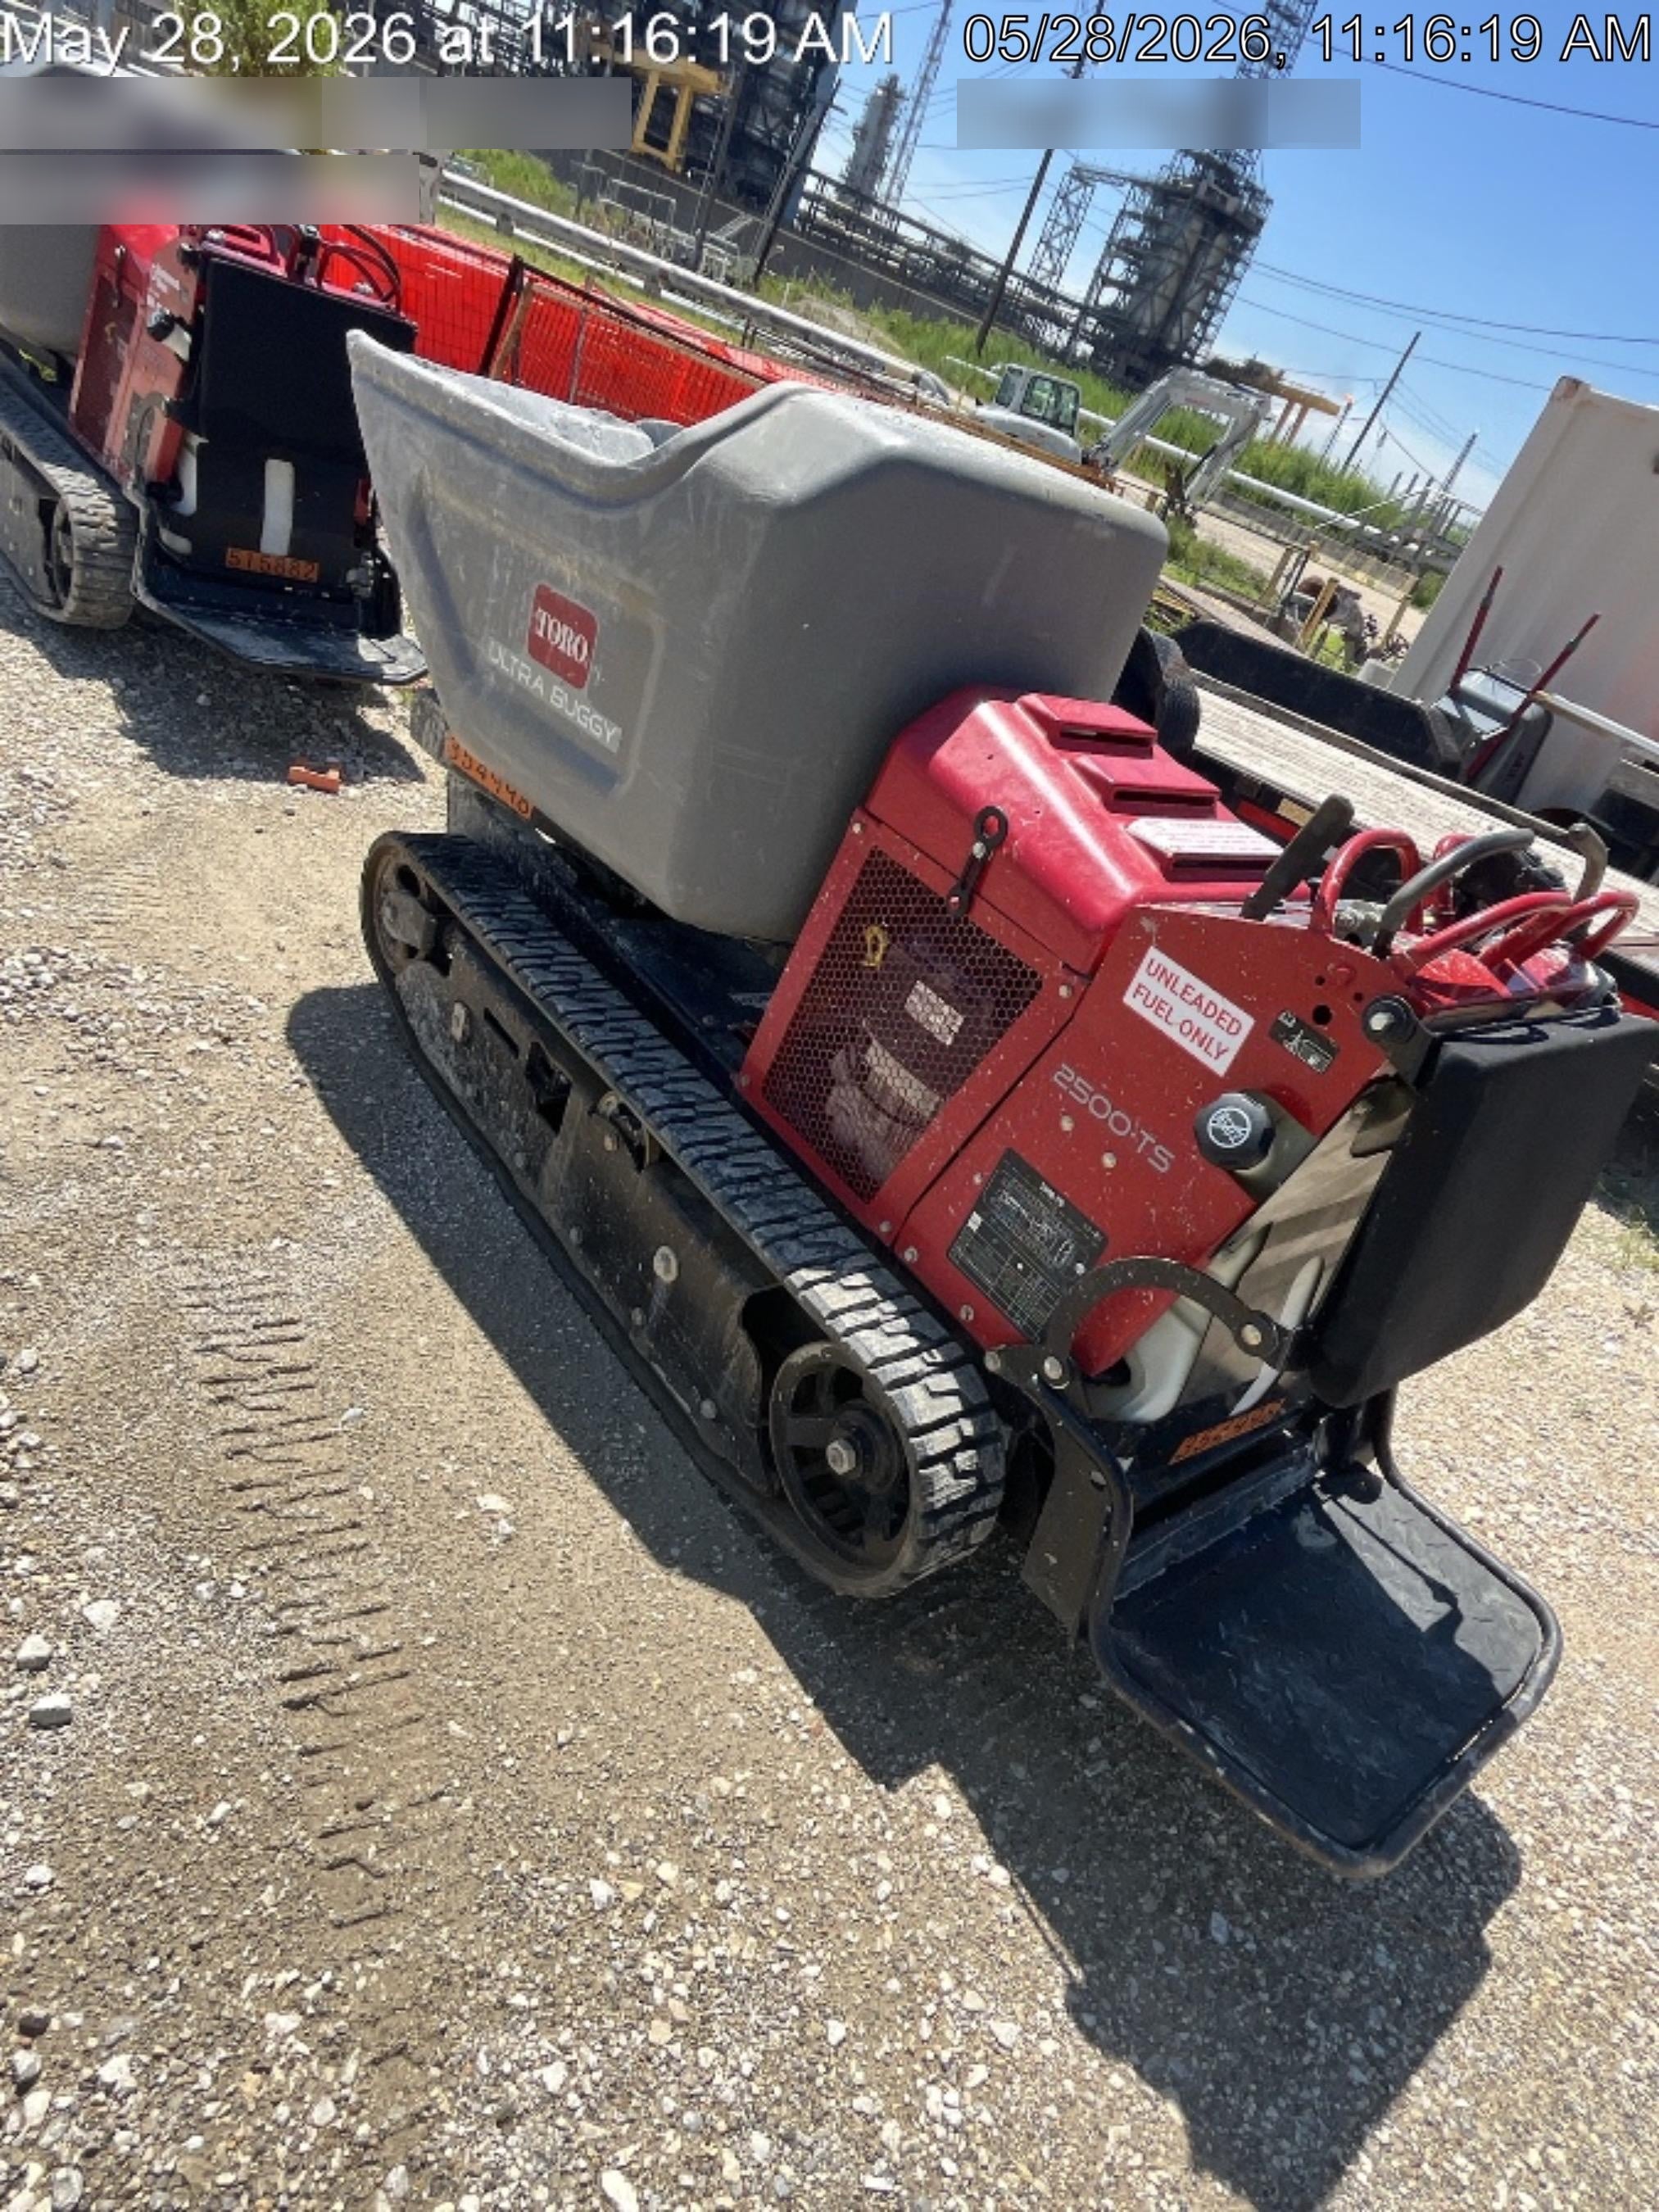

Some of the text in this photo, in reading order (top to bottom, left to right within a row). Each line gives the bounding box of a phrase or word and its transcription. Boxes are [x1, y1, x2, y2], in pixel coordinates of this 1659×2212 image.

[535, 606, 588, 662] TORO
[488, 639, 618, 743] ULTRA BUGGY
[1132, 982, 1174, 1026] FUEL
[1179, 1018, 1230, 1061] ONLY
[1146, 958, 1242, 1036] UNLEADED
